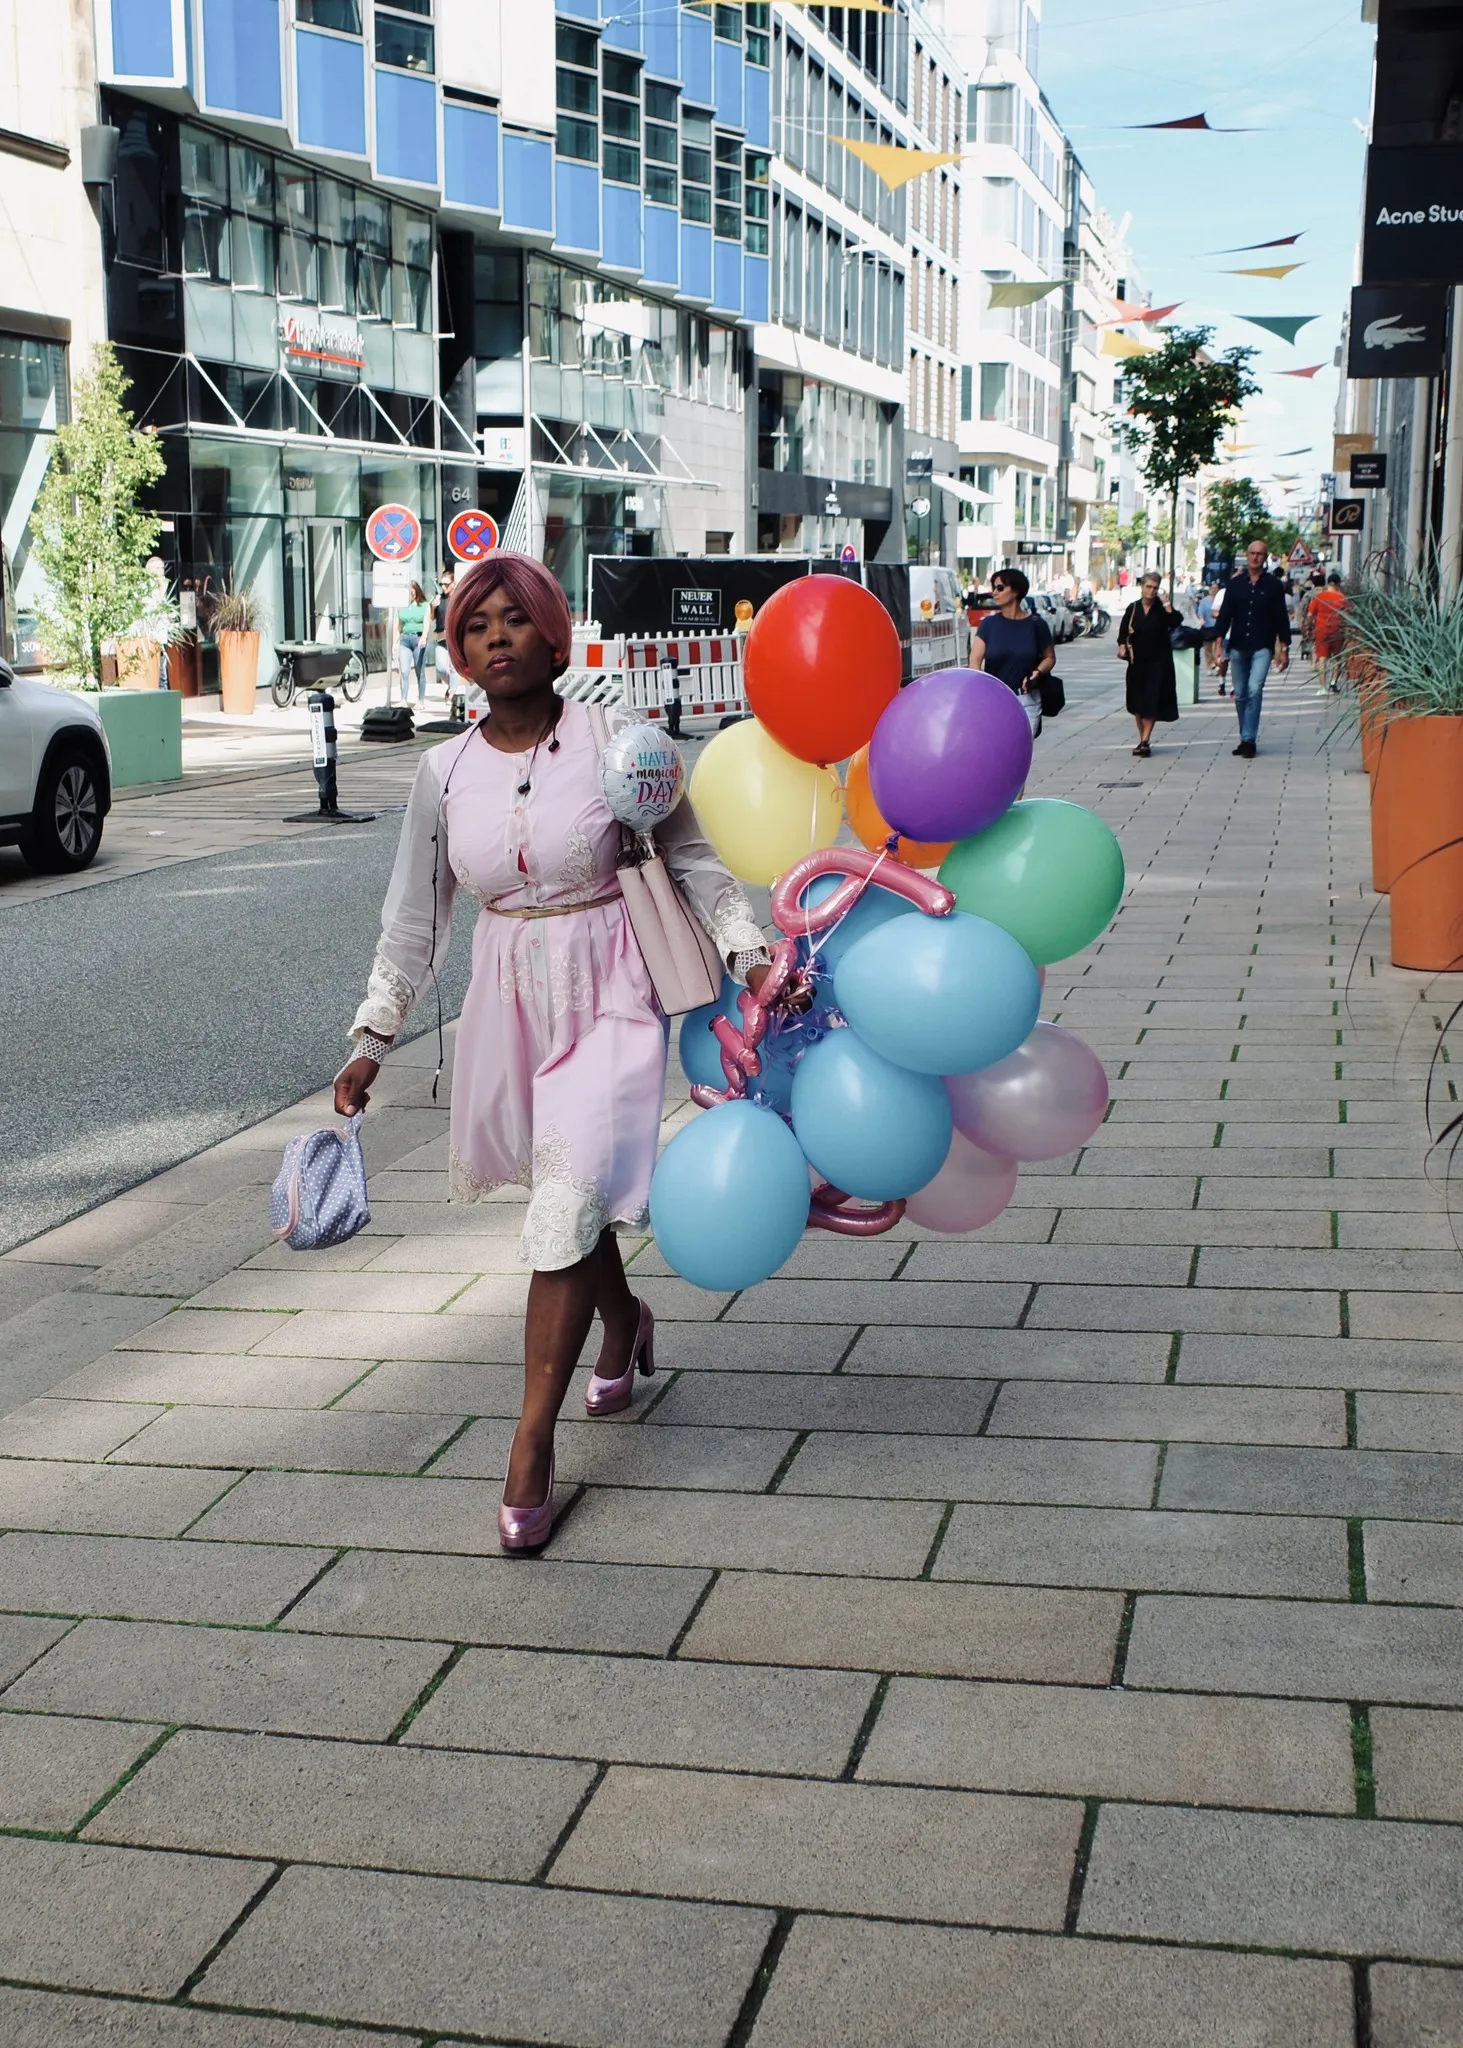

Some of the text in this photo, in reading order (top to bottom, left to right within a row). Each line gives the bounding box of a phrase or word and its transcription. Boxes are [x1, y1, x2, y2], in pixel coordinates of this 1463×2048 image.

[1376, 206, 1426, 226] Acne
[451, 487, 472, 502] 64
[680, 591, 713, 601] NEUER
[680, 604, 713, 615] WALL
[638, 750, 679, 767] HAVE A
[636, 765, 681, 782] magical
[636, 780, 678, 804] DAY
